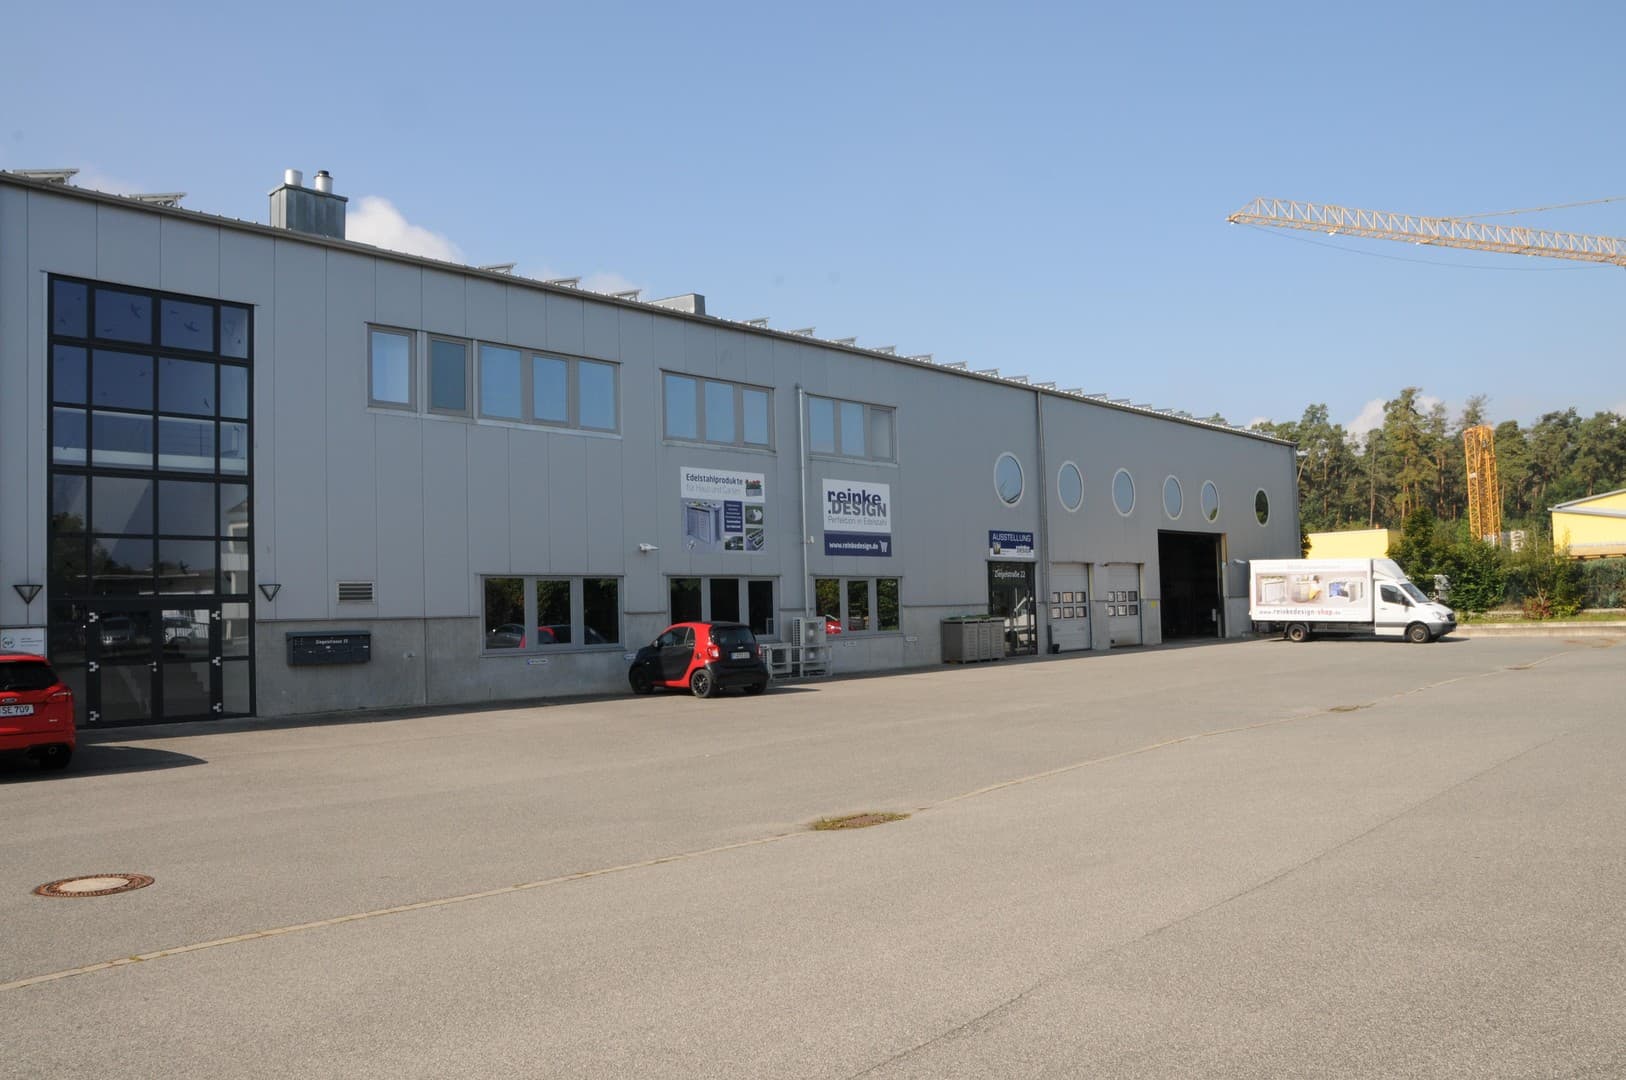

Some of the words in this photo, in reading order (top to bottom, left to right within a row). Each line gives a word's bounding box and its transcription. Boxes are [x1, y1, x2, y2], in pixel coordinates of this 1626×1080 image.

[686, 473, 743, 485] Edelstahlprodukte
[827, 488, 882, 506] reinke
[992, 533, 1032, 543] AUSSTELLUNG
[14, 705, 30, 713] 709
